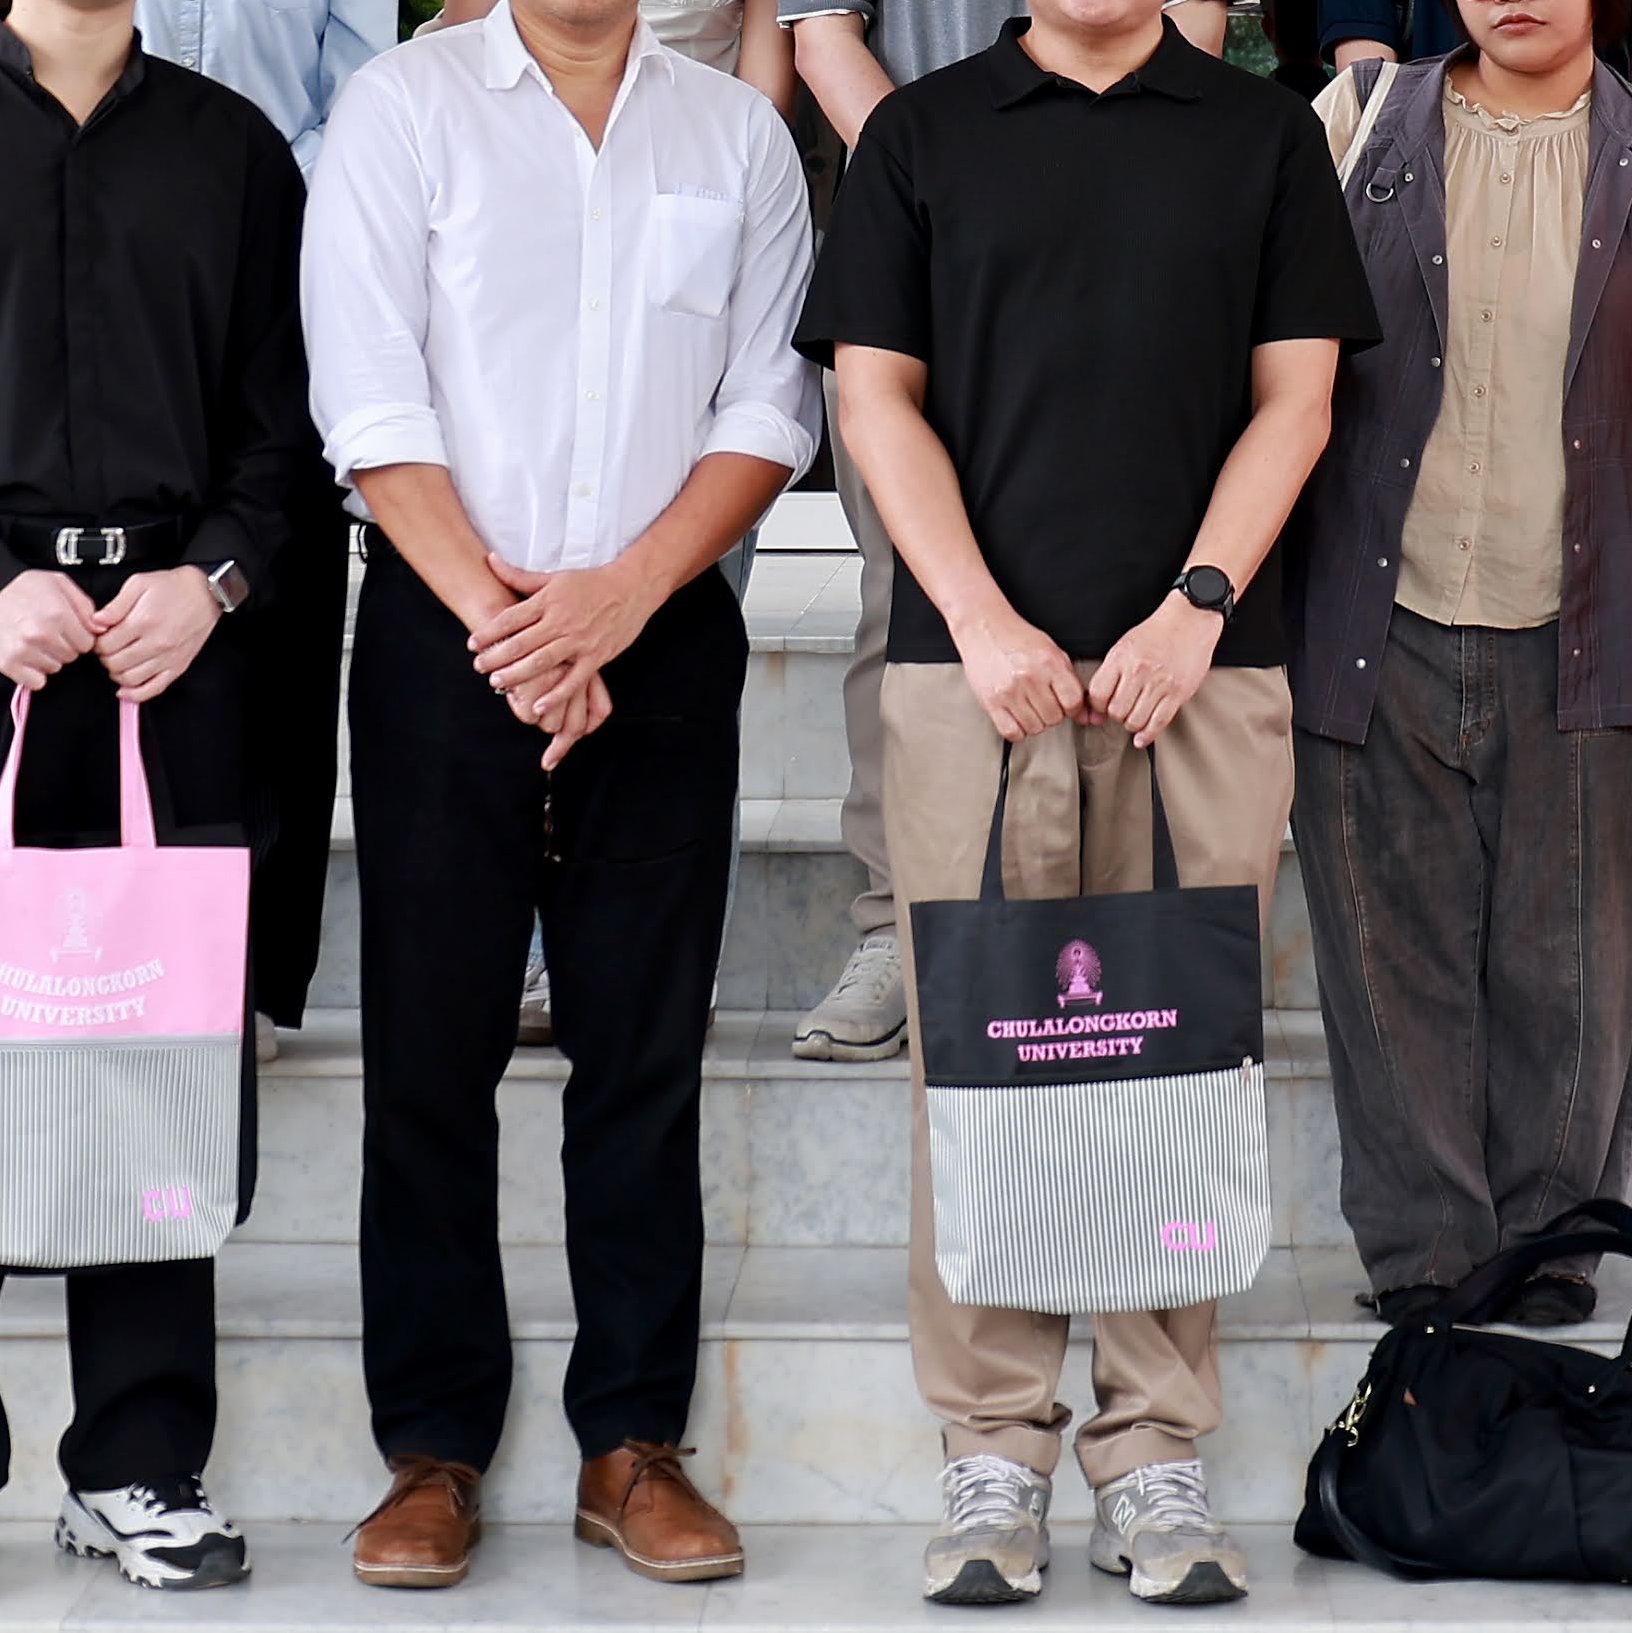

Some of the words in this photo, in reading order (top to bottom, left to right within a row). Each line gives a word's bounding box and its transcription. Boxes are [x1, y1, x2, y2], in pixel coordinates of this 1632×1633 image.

[0, 995, 145, 1025] UNIVERSITY
[987, 1009, 1178, 1039] CHULALONGKORN
[1017, 1036, 1144, 1062] UNIVERSITY
[142, 1185, 192, 1221] CU
[1161, 1220, 1216, 1252] CU
